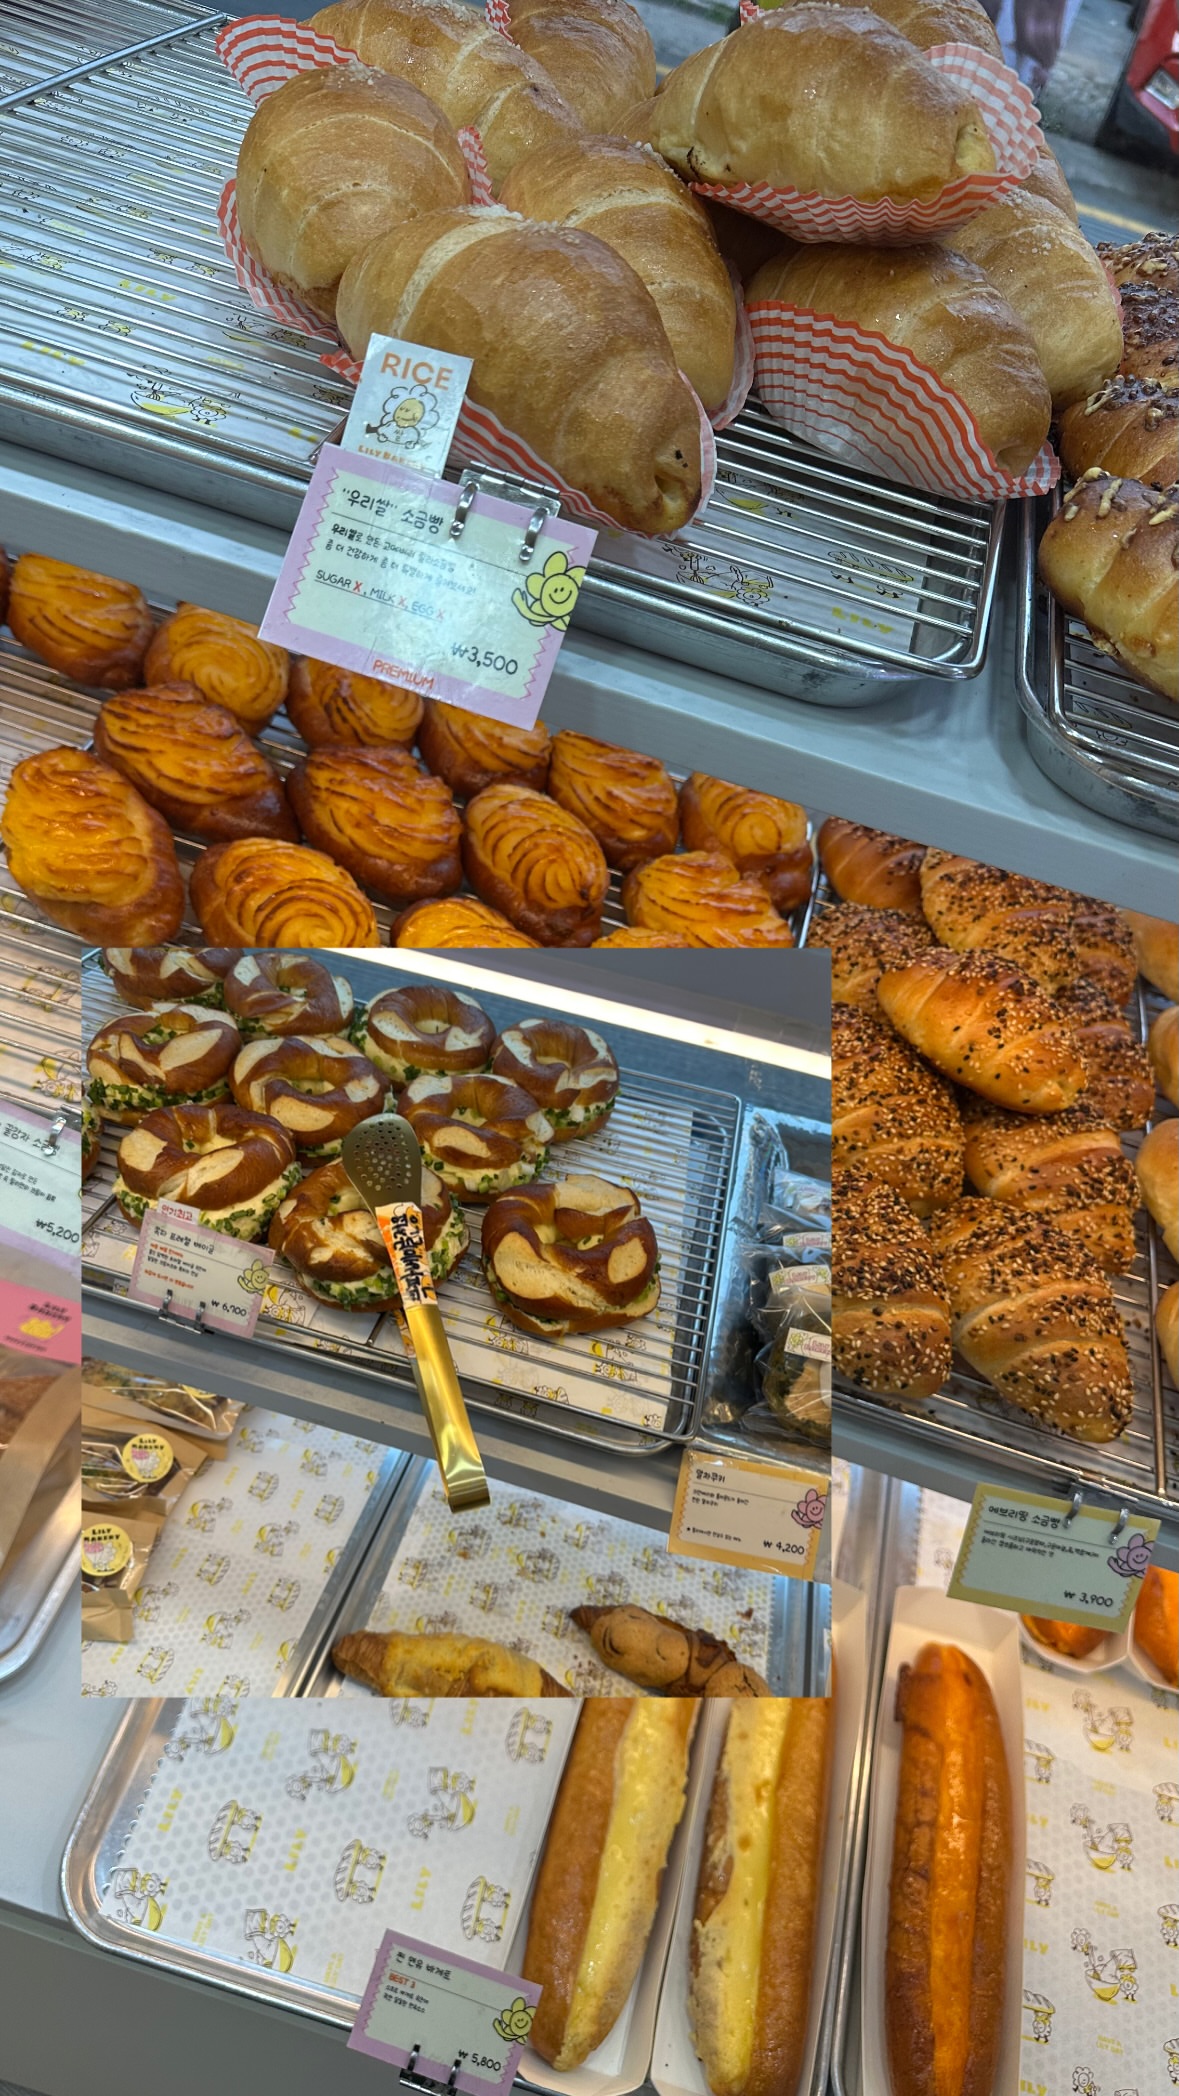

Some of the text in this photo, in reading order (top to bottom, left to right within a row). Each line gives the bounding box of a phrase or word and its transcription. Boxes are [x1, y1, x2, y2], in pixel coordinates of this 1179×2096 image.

[380, 352, 453, 391] RICE
[401, 509, 444, 535] 소금빵
[335, 543, 345, 553] 더
[346, 546, 379, 563] 건강하게
[316, 570, 352, 588] SUGAR
[370, 587, 396, 603] MILK
[411, 601, 434, 616] EGG
[436, 609, 446, 620] X
[450, 642, 519, 676] ₩3,500
[372, 659, 435, 690] PREMIUM
[161, 1204, 193, 1222] 인기최고
[36, 1219, 79, 1243] ₩5,200
[1031, 1514, 1060, 1529] 소금빵
[776, 1541, 805, 1555] 4,200
[1079, 1592, 1113, 1607] 3,900
[389, 1972, 409, 1985] BEST
[408, 1956, 423, 1969] 연유
[426, 1964, 452, 1980] 바게트
[472, 2053, 501, 2072] 5,800
